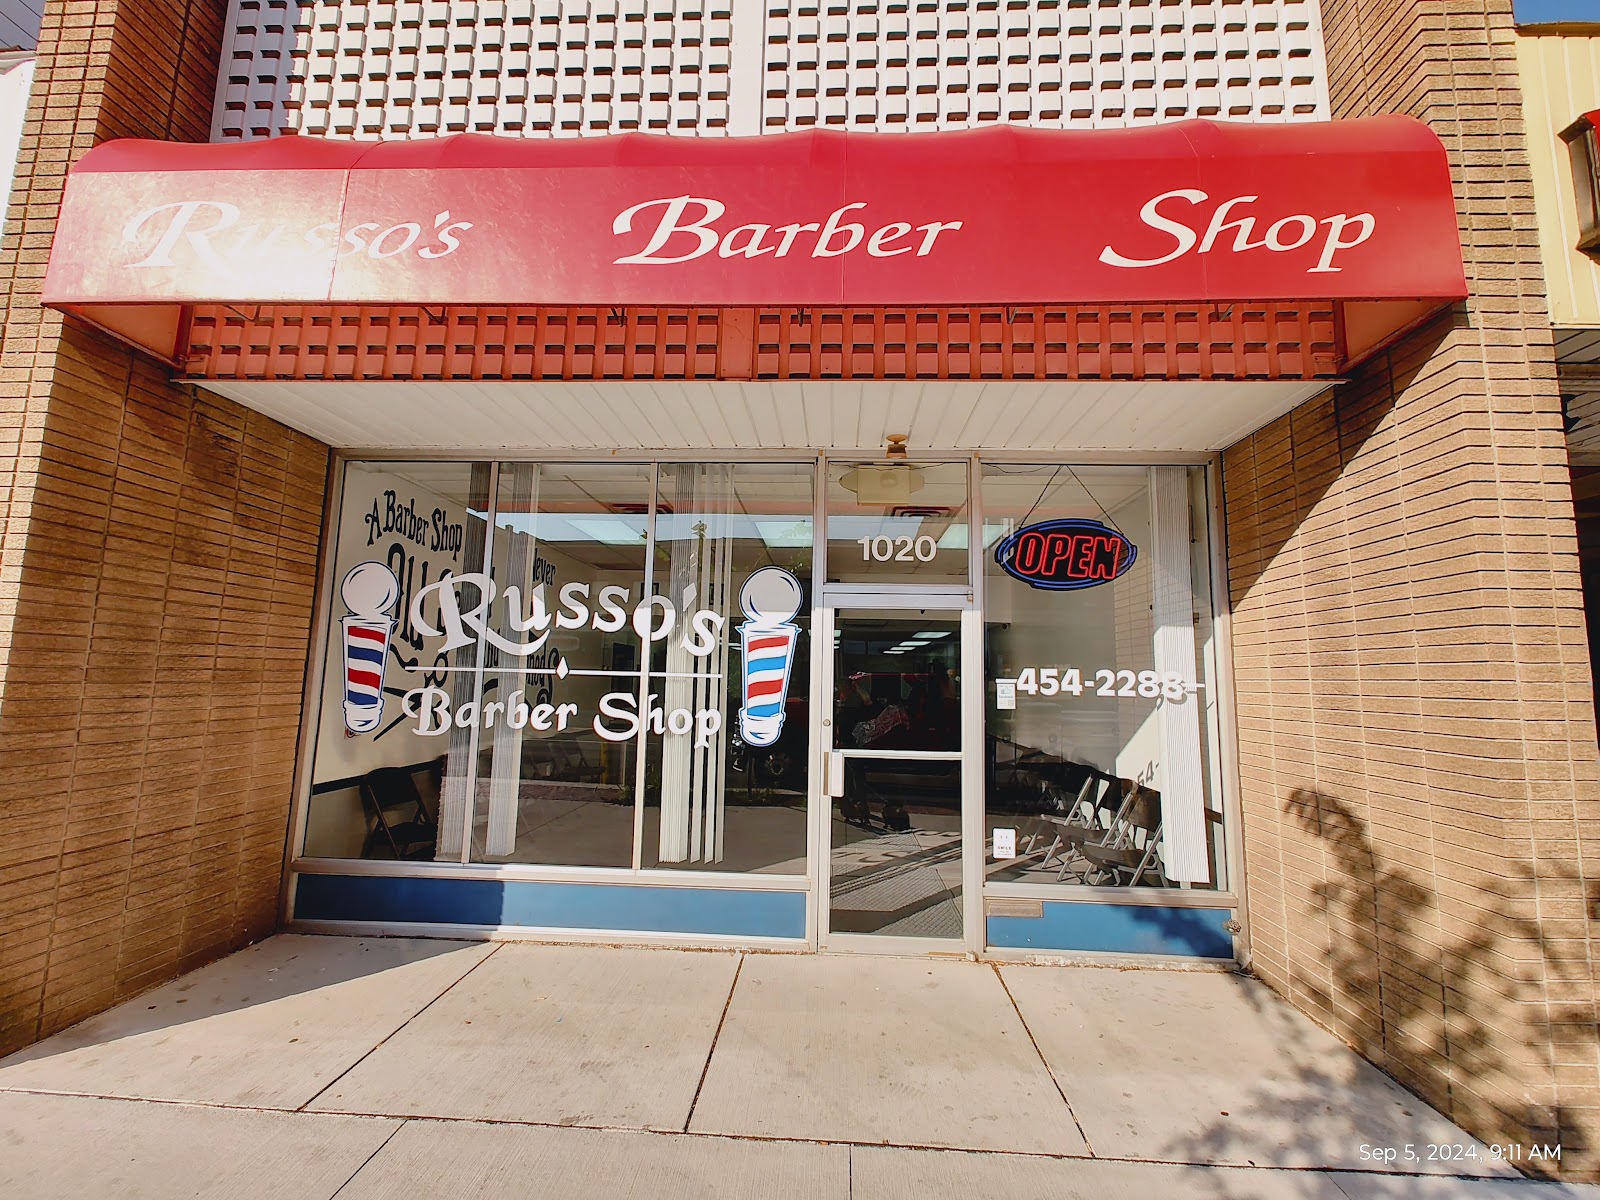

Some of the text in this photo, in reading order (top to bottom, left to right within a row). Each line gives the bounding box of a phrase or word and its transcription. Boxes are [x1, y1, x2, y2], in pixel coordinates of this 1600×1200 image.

[122, 189, 1377, 273] Russo's Barber Shop
[365, 490, 556, 586] A Barber Shop ever
[857, 535, 938, 562] 1020
[1015, 532, 1121, 580] OPEN
[410, 572, 726, 657] Russo's
[401, 685, 722, 750] Barber Shop
